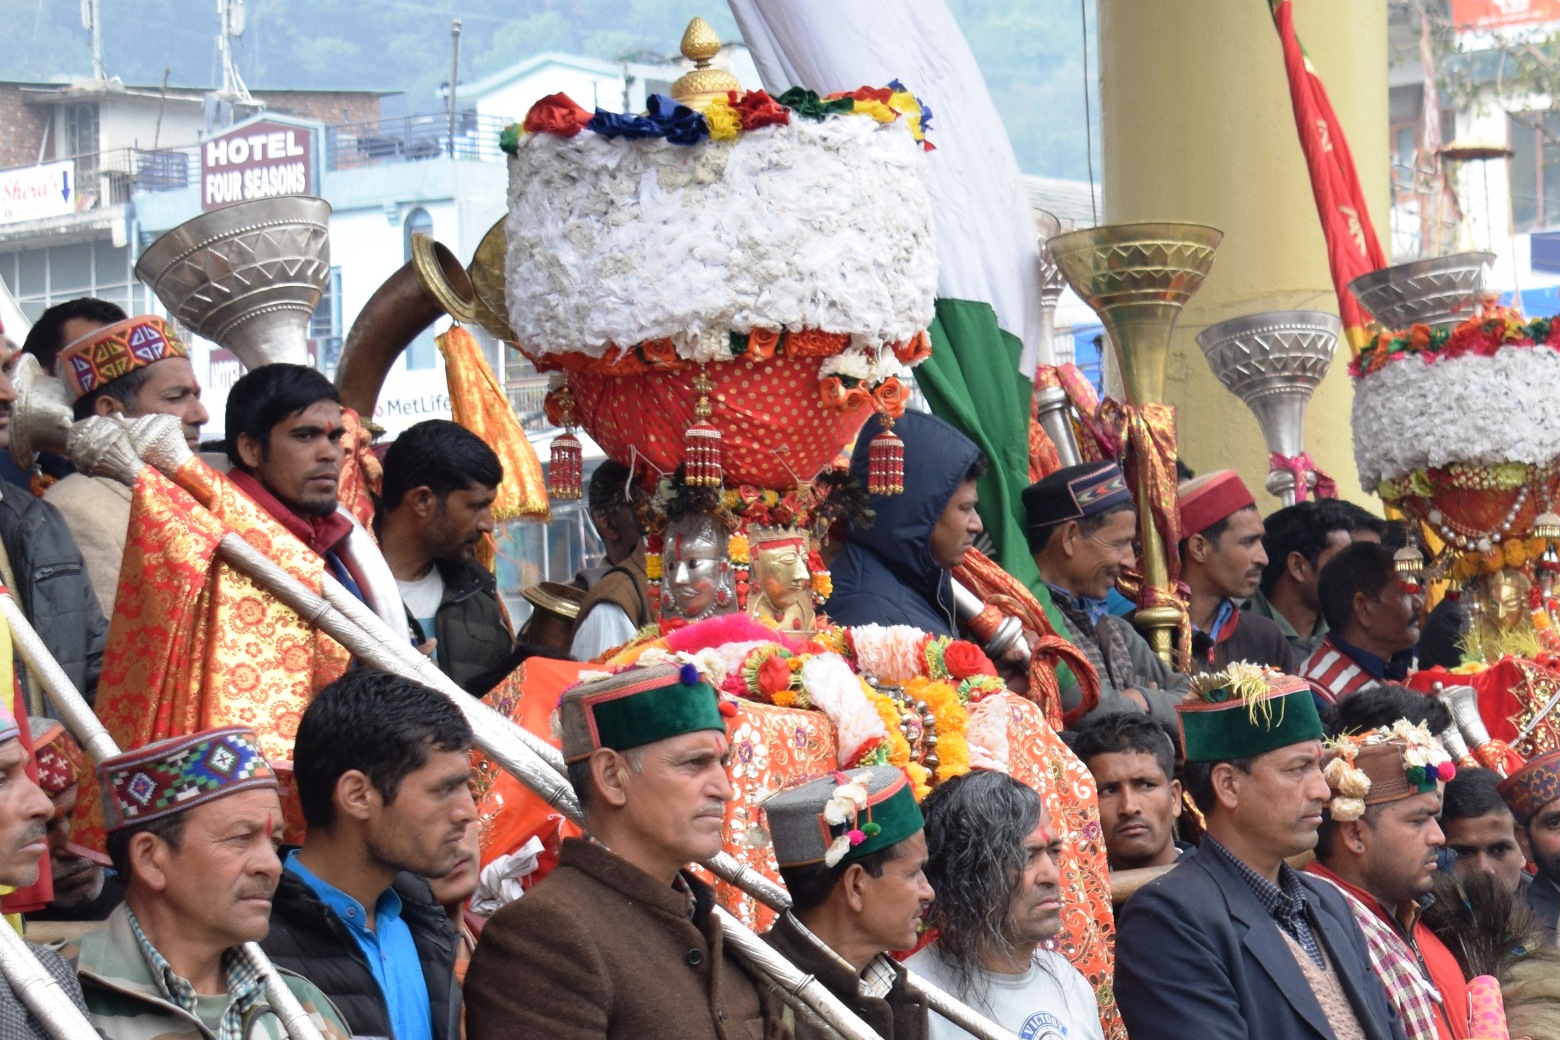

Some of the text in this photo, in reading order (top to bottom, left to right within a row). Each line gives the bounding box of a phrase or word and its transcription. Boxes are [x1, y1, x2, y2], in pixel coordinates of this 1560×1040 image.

[207, 130, 304, 167] HOTEL
[206, 161, 306, 204] FOUR SEASONS
[387, 393, 452, 416] MetLife
